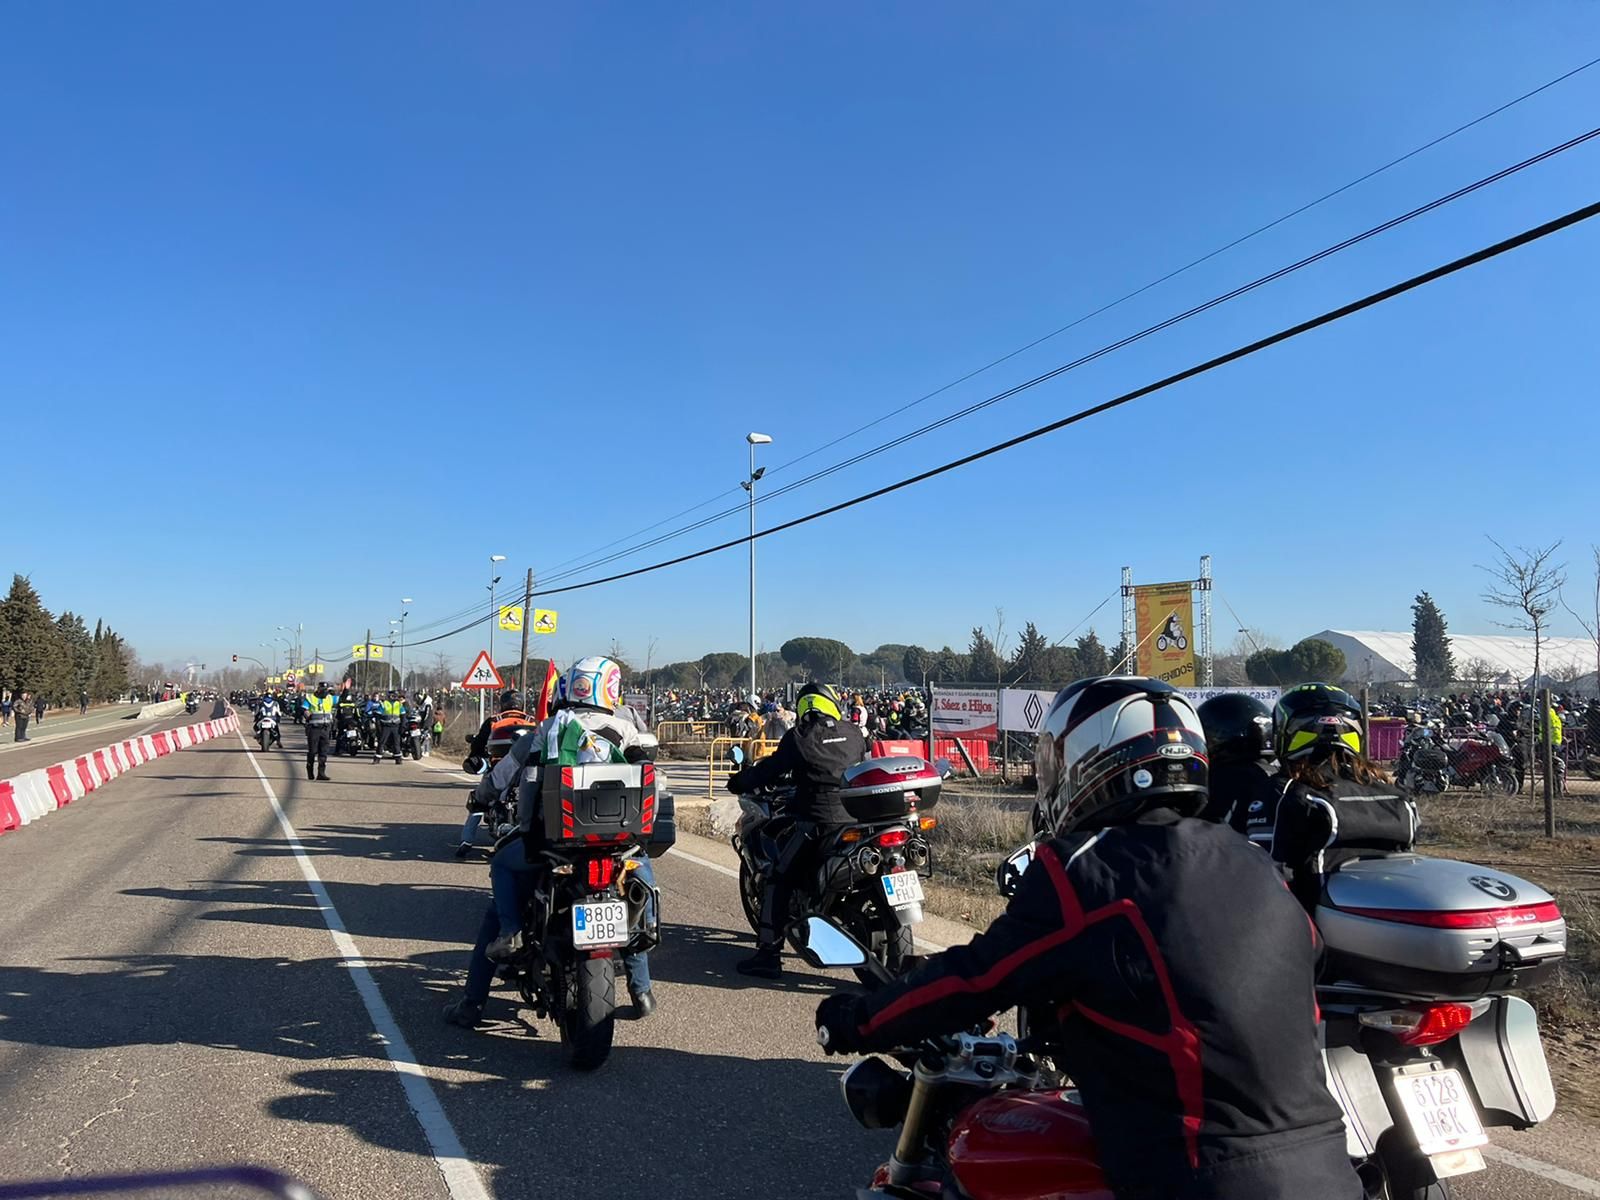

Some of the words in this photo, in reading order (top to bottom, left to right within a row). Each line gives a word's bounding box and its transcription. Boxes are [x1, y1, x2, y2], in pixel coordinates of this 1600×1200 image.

[934, 698, 940, 711] J.
[962, 702, 967, 711] e
[968, 699, 992, 714] Hijos
[871, 785, 902, 795] HONDA
[890, 873, 917, 888] 7979
[896, 887, 916, 901] FHJ
[585, 905, 623, 923] 8803
[587, 923, 615, 940] JBB
[1412, 1075, 1458, 1107] 6128
